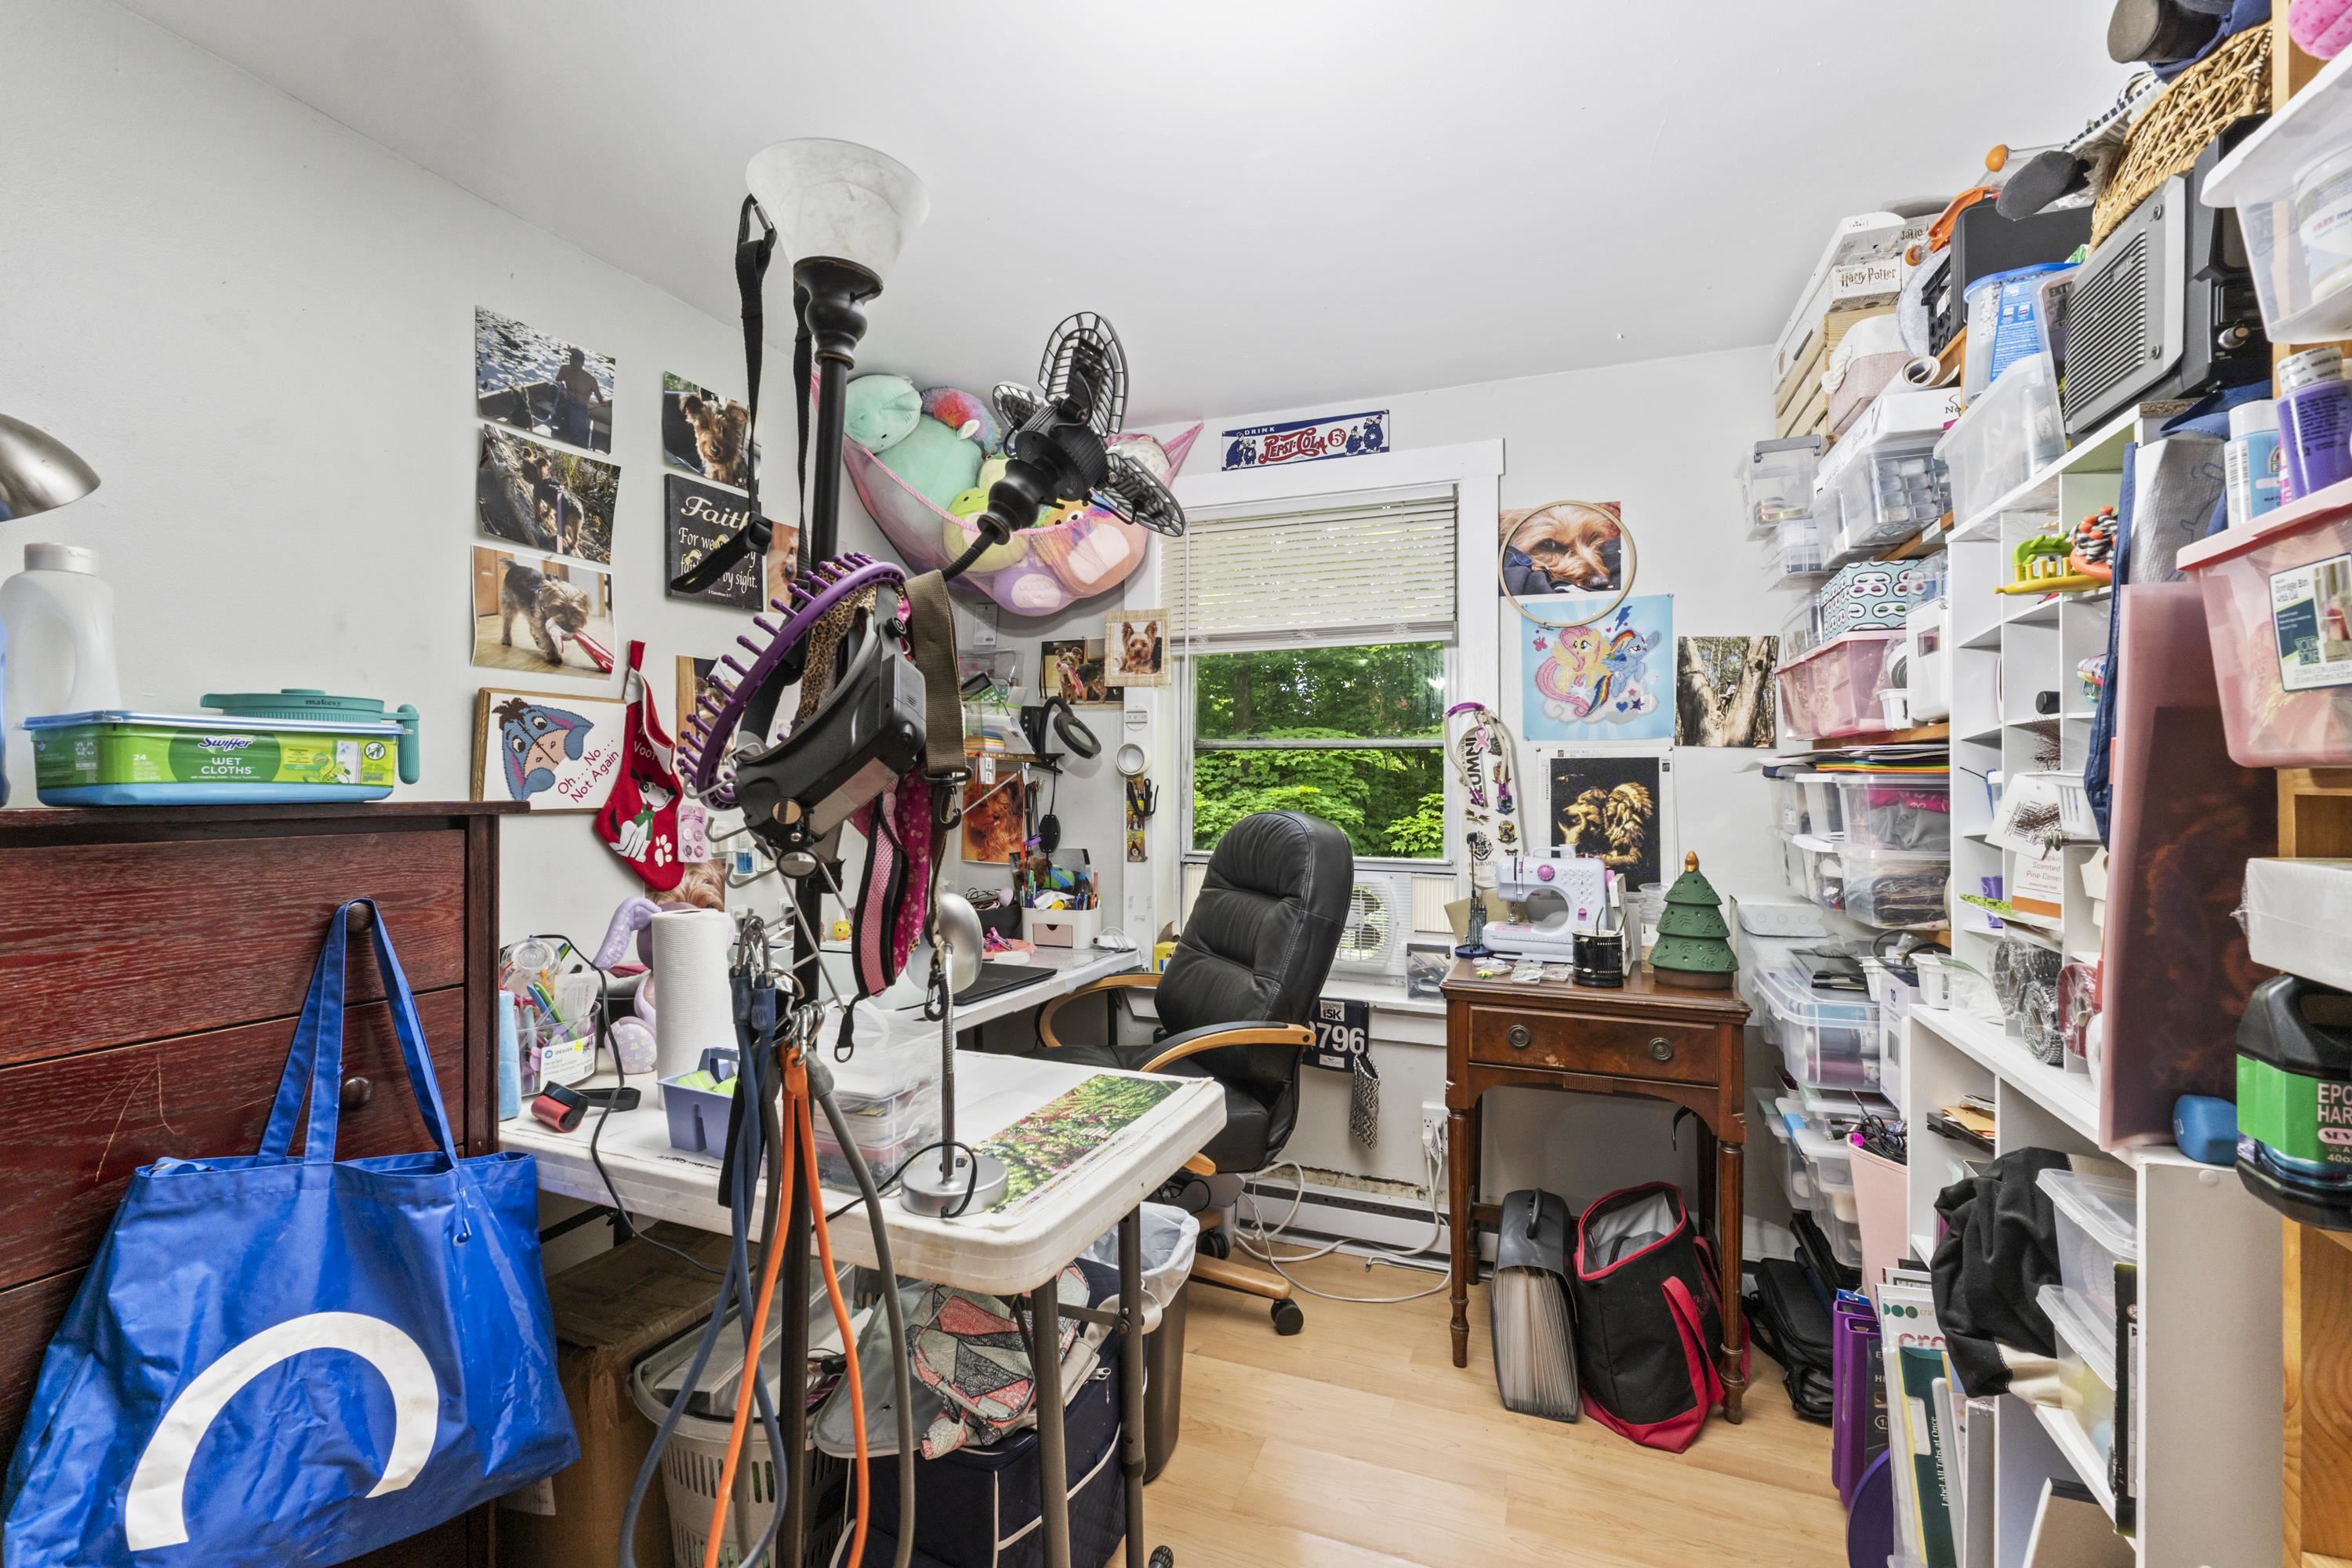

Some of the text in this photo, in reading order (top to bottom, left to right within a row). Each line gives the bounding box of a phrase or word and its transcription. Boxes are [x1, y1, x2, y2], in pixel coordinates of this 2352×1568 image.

[1840, 267, 1896, 287] Harry Potter
[1244, 426, 1275, 435] DRINK
[678, 527, 699, 546] For
[735, 569, 757, 594] sight.
[305, 699, 342, 707] makesy
[198, 735, 252, 752] Swiffer
[201, 766, 252, 775] CLOTHS
[571, 751, 619, 803] Not Again
[2032, 862, 2060, 872] Scented
[2027, 870, 2040, 879] Pine
[1933, 1439, 1940, 1448] at
[1935, 1449, 1944, 1469] Tabs
[1936, 1470, 1945, 1483] All
